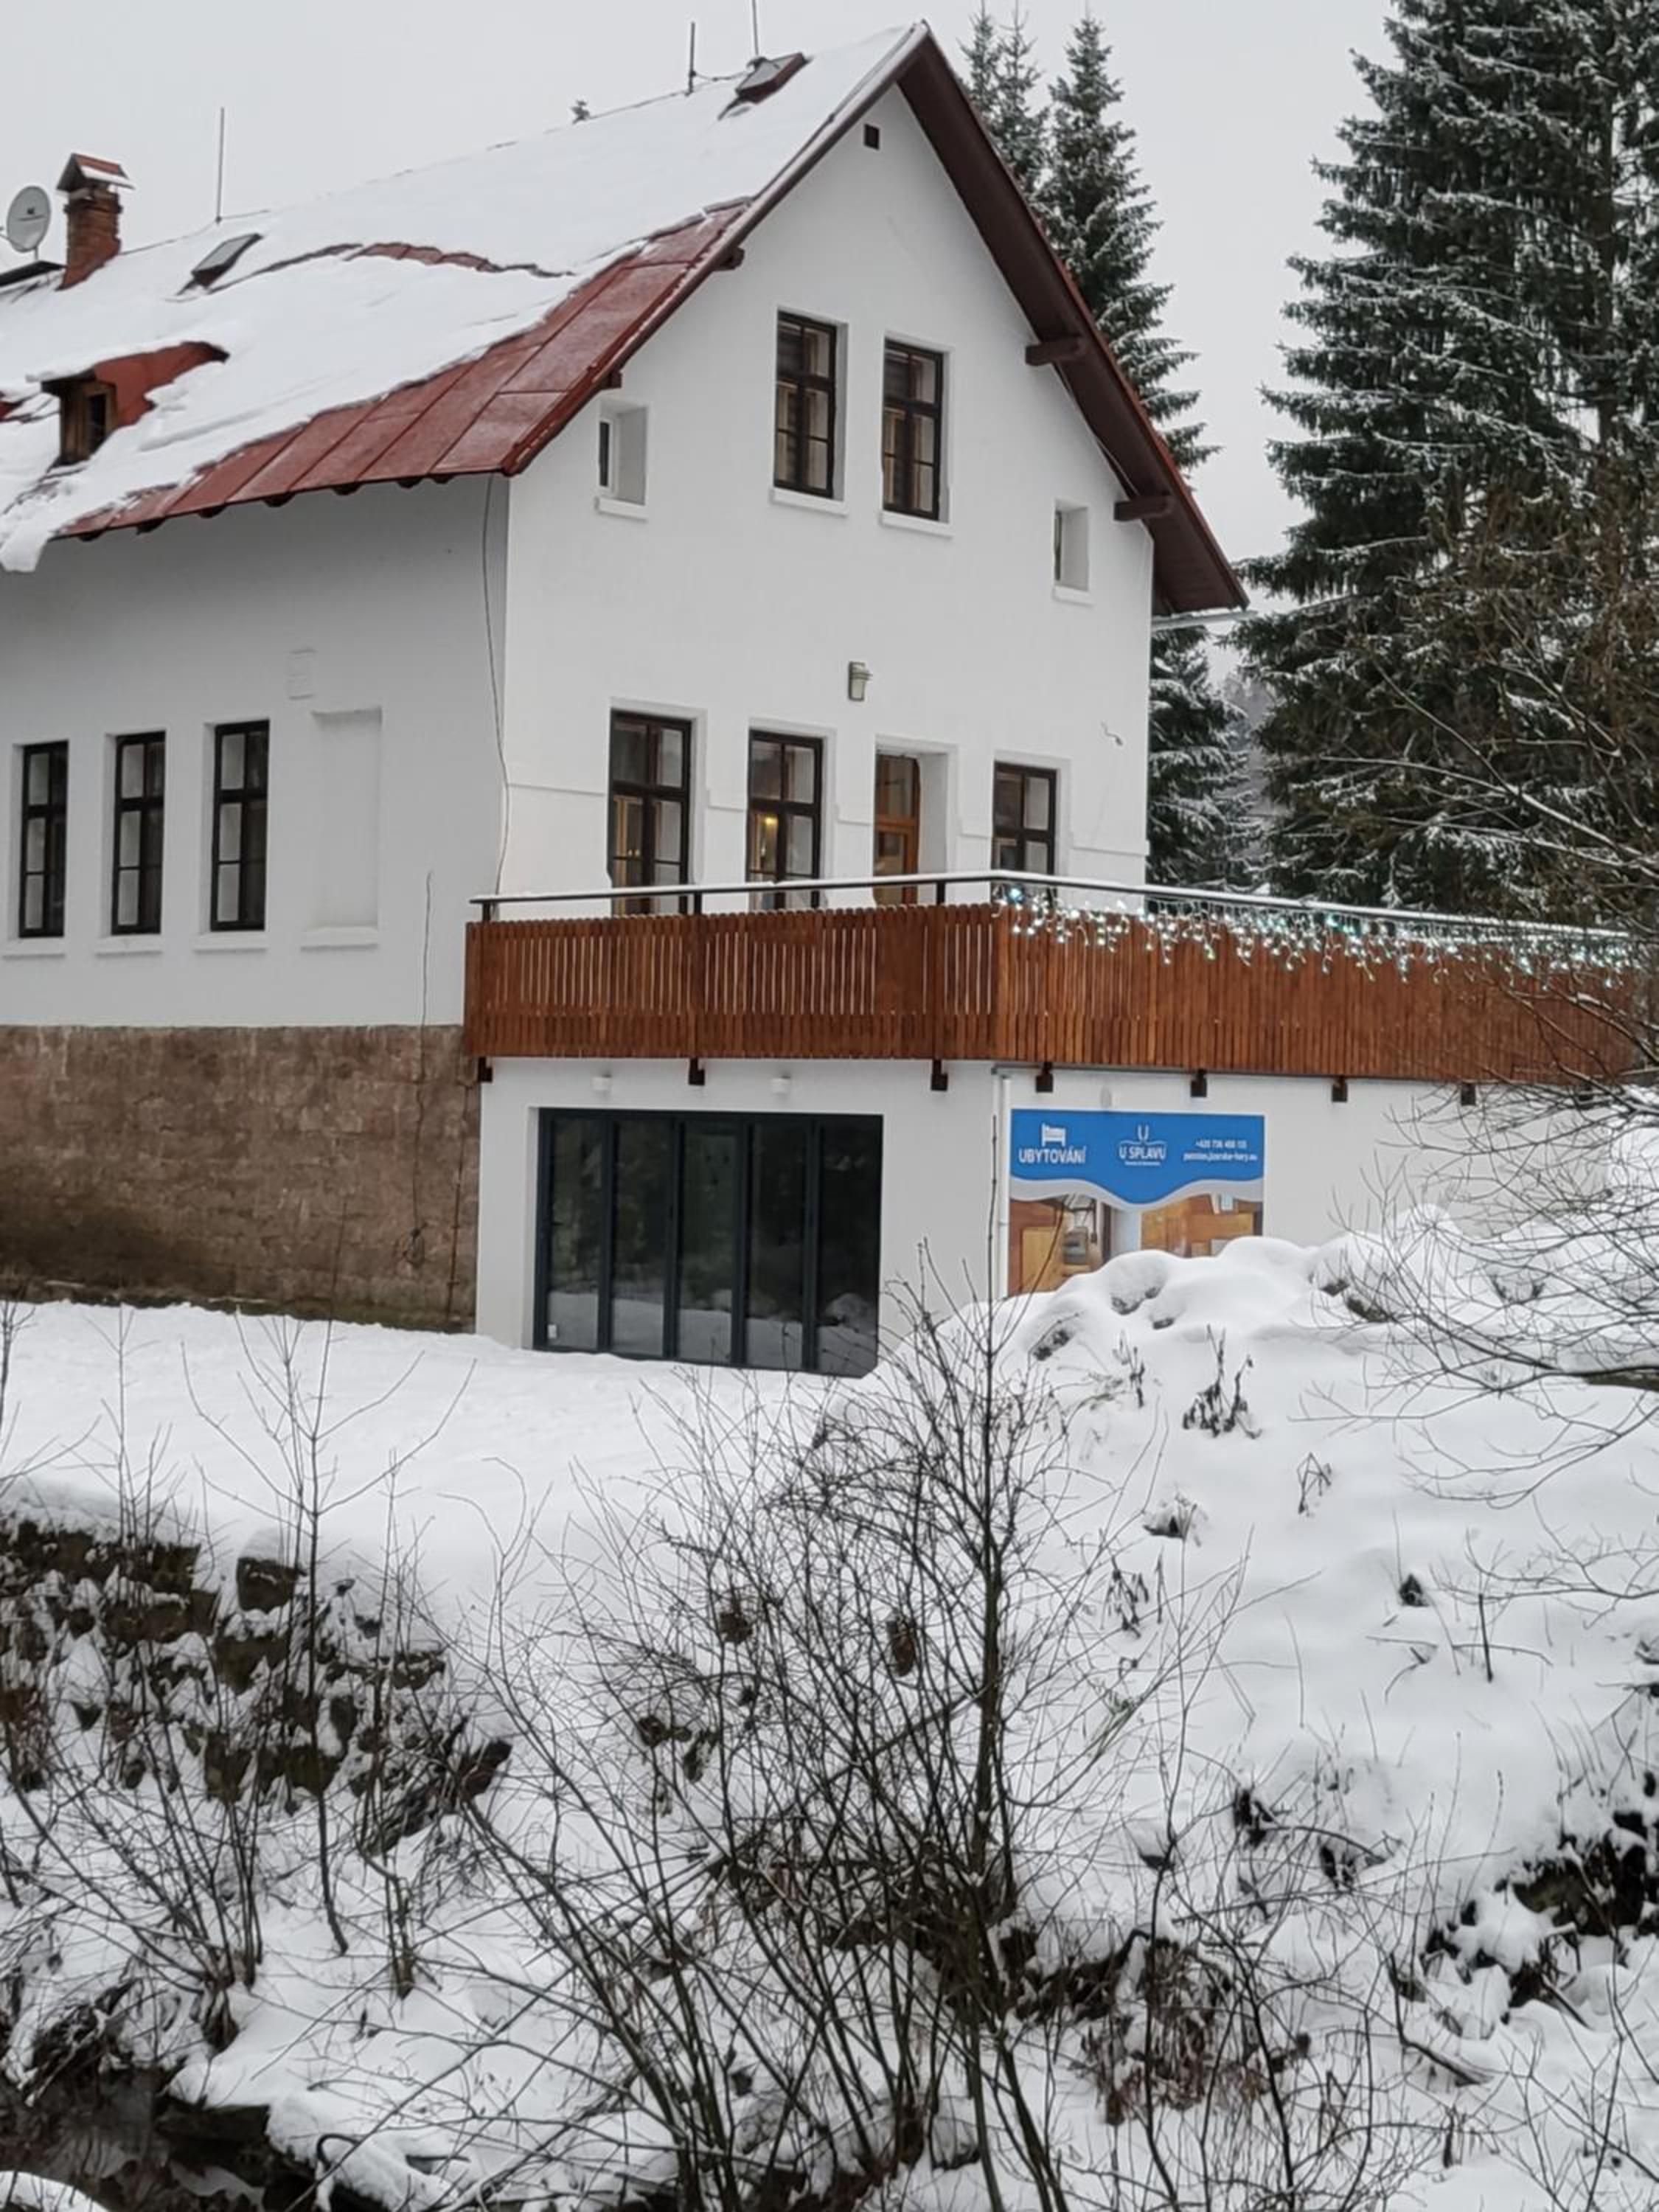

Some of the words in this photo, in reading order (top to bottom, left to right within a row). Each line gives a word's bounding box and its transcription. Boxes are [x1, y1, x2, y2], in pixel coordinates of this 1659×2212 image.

[1018, 1145, 1086, 1164] UBYTOVÁNÍ
[1119, 1147, 1127, 1159] U
[1129, 1147, 1166, 1160] SPLAVU
